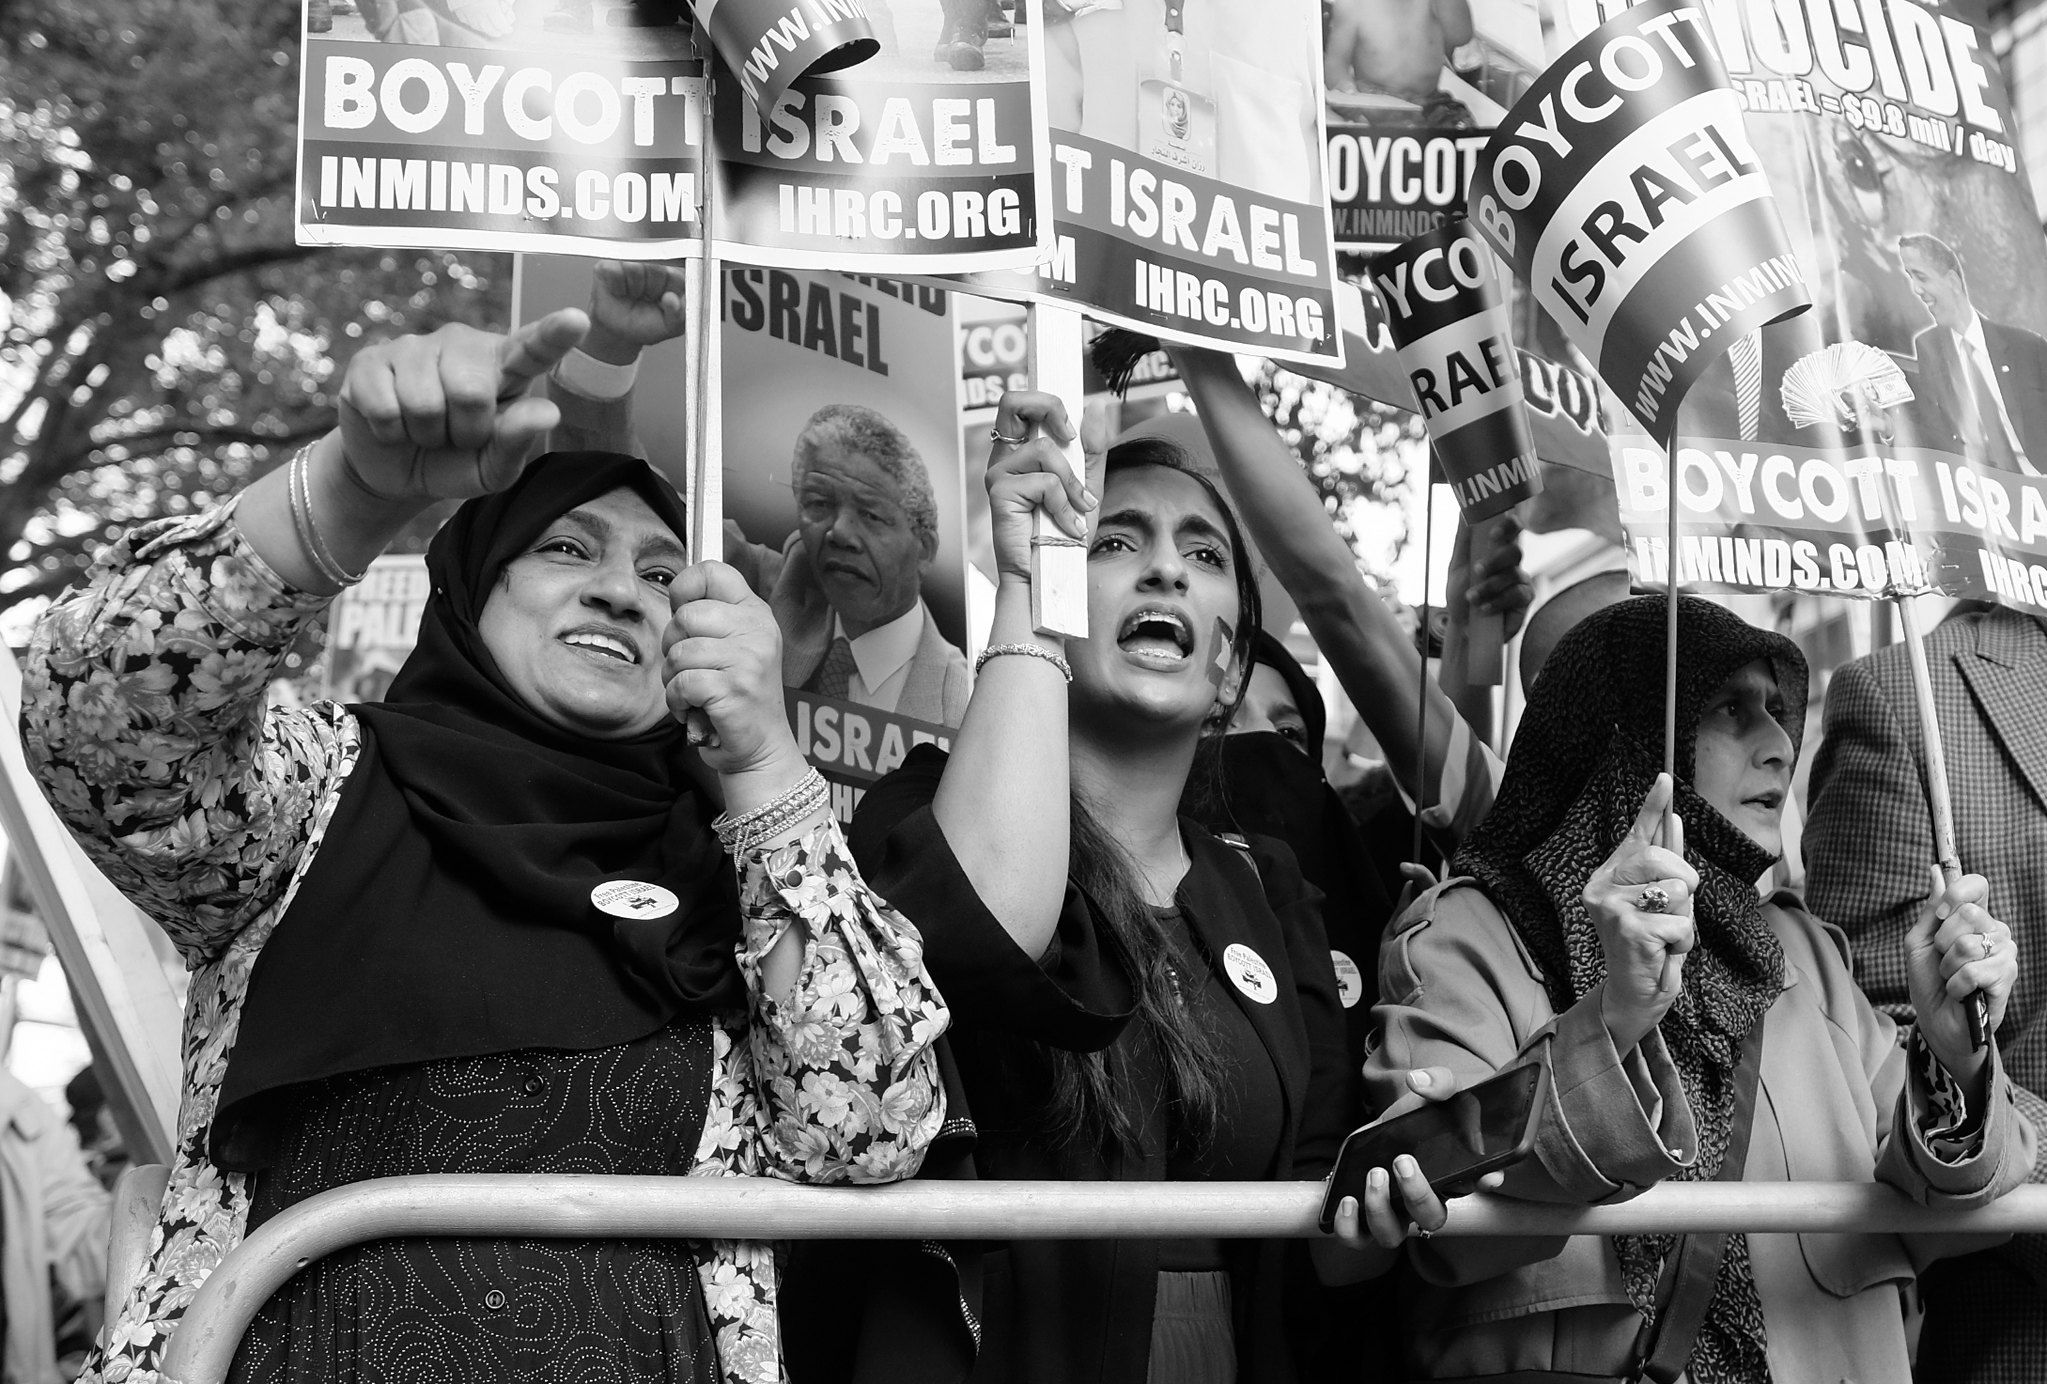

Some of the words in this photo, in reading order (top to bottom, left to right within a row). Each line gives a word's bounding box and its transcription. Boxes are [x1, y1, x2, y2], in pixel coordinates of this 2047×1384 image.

[324, 56, 716, 146] BOYCOTT
[742, 88, 1017, 166] ISRAEL
[1479, 8, 1721, 258] BOYCOTT
[1969, 130, 2018, 174] day
[319, 156, 696, 222] INMINDS.COM
[779, 184, 1021, 240] IHRC.ORG
[1109, 159, 1317, 277] ISRAEL
[1551, 124, 1760, 326] ISRAEL
[1135, 258, 1325, 341] IHRC.ORG
[1622, 448, 1919, 524] BOYCOTT
[1635, 535, 1924, 591] INMINDS.COM
[797, 701, 950, 775] ISRA
